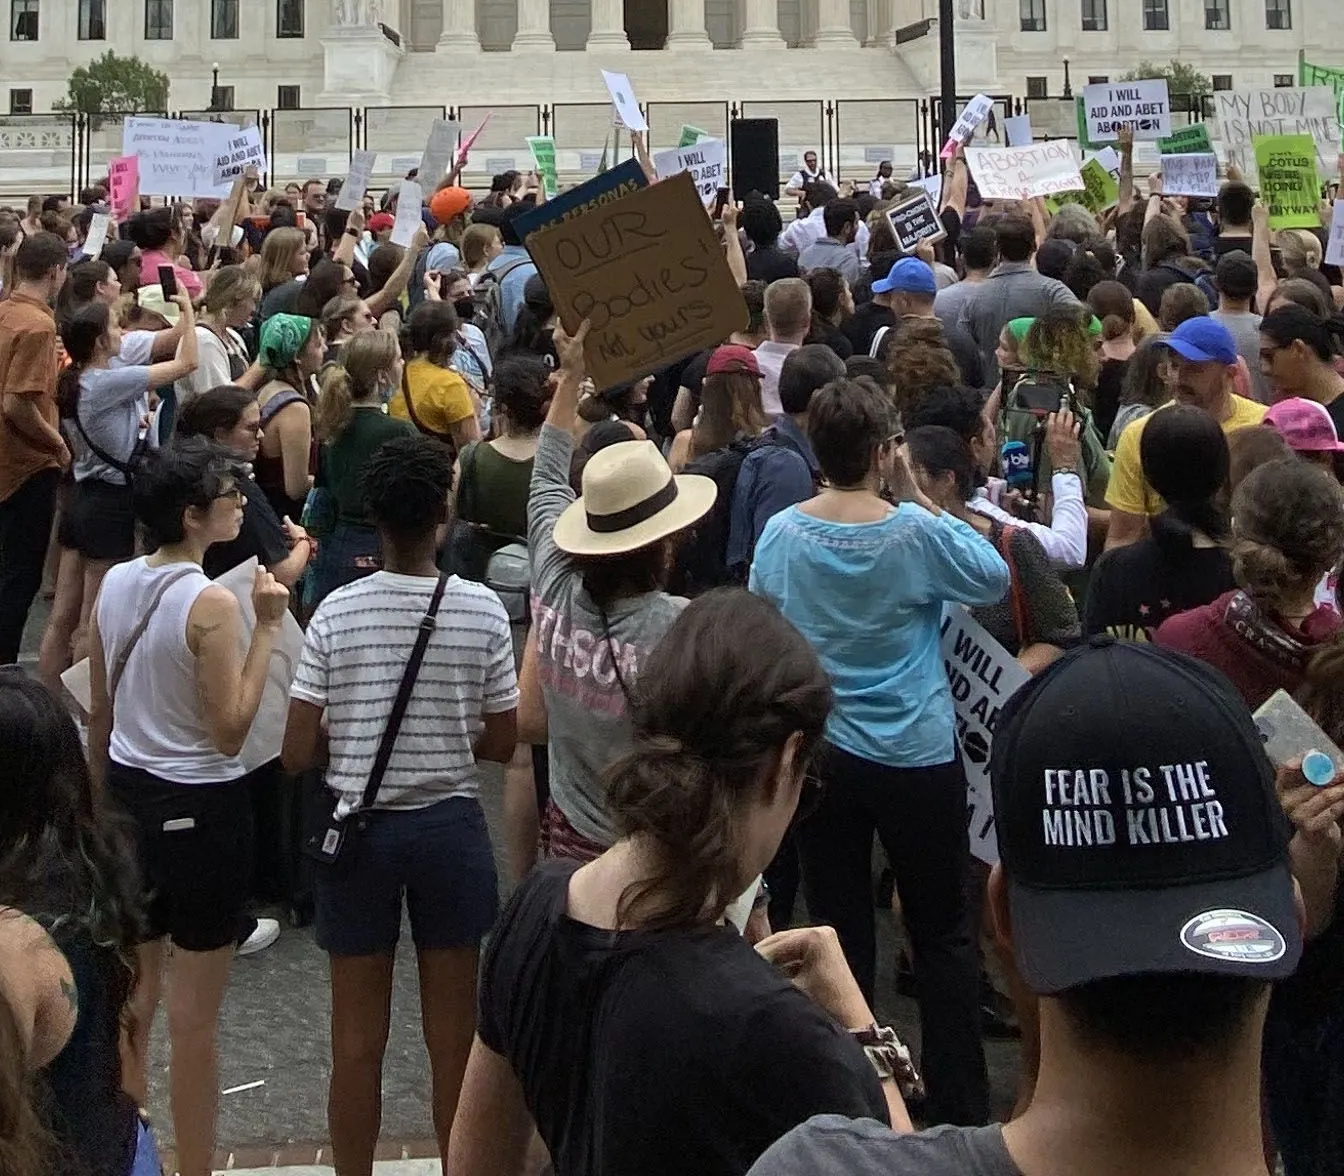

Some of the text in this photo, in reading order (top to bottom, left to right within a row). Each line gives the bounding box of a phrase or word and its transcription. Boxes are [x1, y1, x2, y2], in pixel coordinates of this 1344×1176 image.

[1115, 88, 1142, 101] WILL
[1220, 91, 1306, 119] MY BODY
[1090, 102, 1164, 119] AID AND ABET
[1223, 119, 1245, 145] IS
[1295, 116, 1339, 144] MINE
[216, 154, 230, 167] AID
[230, 150, 246, 164] AND
[684, 150, 706, 167] WILL
[700, 163, 722, 179] ABET
[976, 144, 1071, 172] ABORTION
[556, 210, 667, 271] OUR
[954, 628, 1004, 695] WILL
[1044, 760, 1216, 806] FEAR IS THE
[1042, 800, 1229, 846] MIND KILLER
